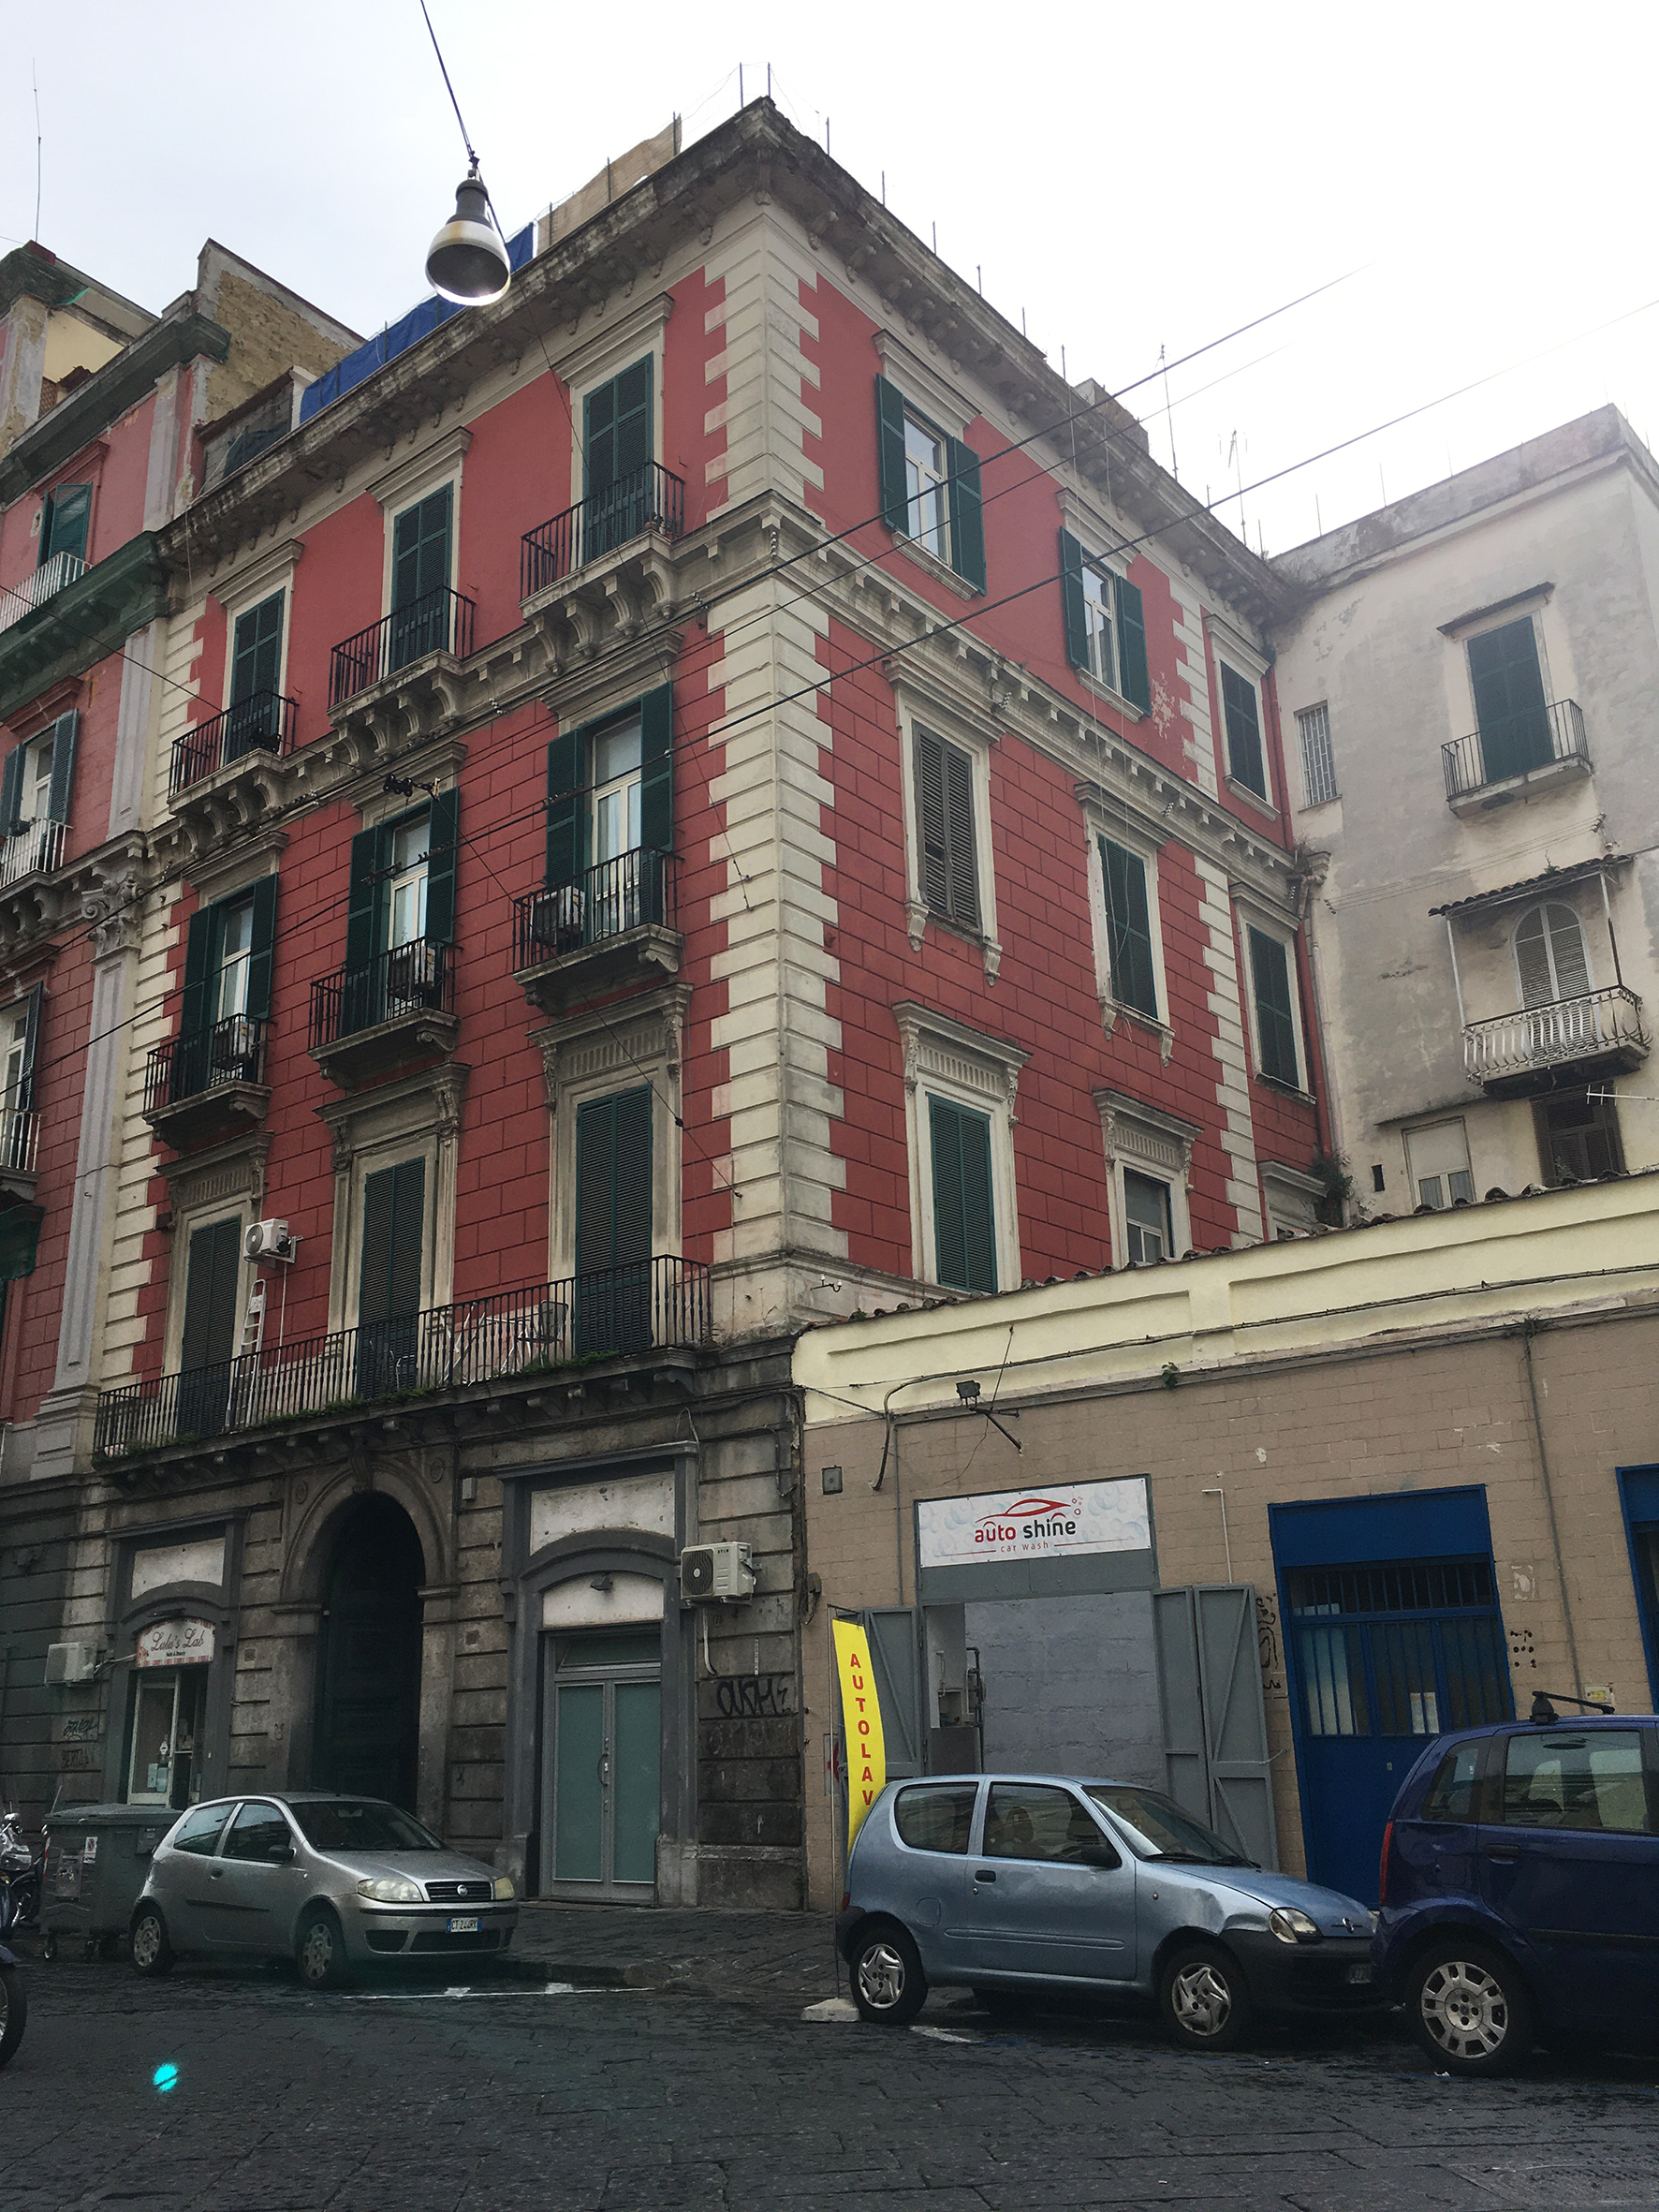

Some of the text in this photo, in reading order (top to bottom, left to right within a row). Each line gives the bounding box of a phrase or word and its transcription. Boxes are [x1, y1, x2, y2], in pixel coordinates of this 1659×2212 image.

[975, 1518, 1076, 1543] auto shine
[1000, 1541, 1049, 1554] car wash
[183, 1628, 205, 1648] Lab
